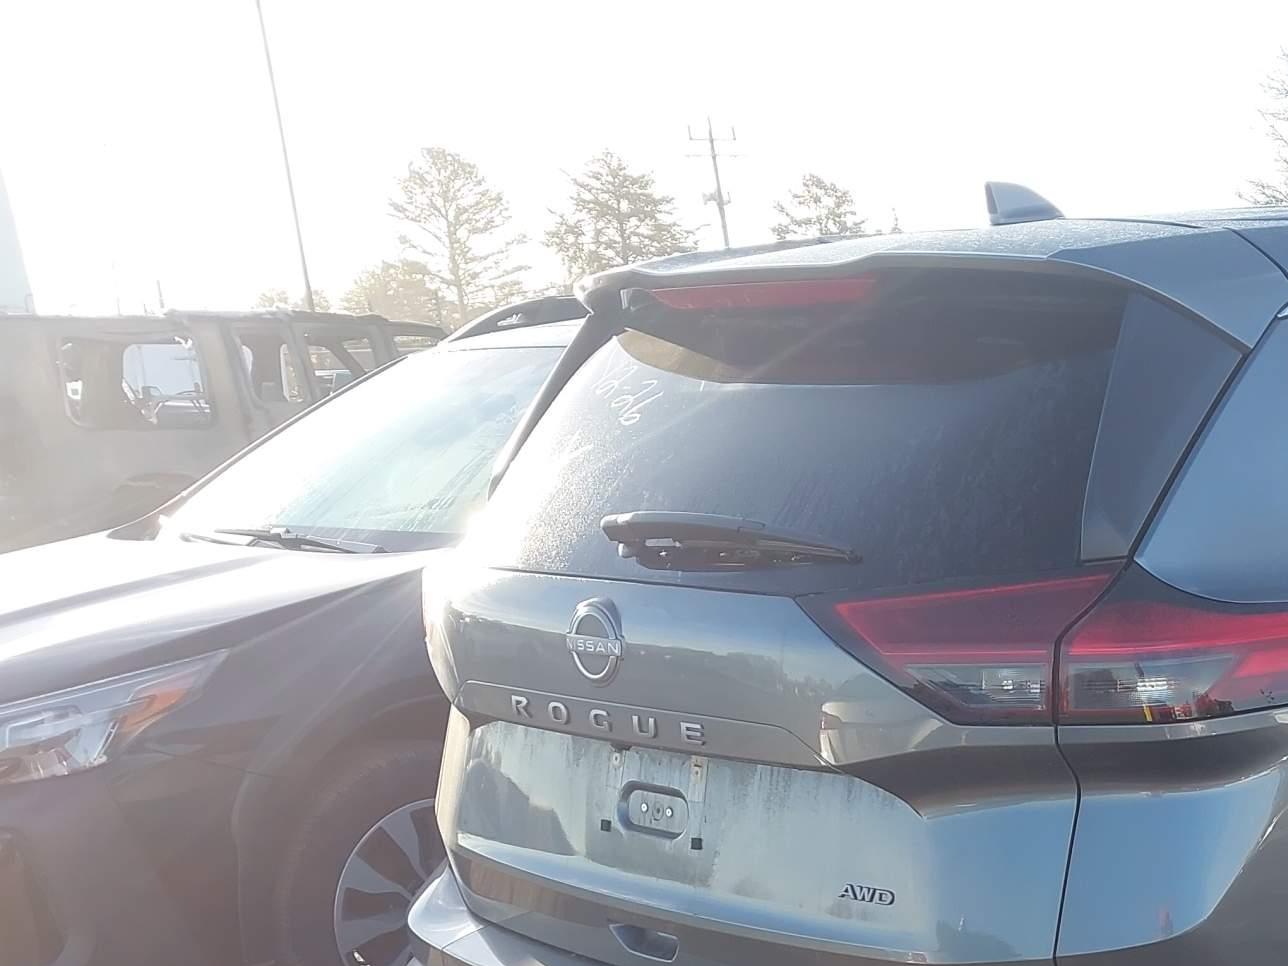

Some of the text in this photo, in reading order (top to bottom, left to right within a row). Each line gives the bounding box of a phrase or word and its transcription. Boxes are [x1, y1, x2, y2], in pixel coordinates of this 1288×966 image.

[567, 638, 621, 655] NISSAN
[511, 694, 707, 746] ROGUE
[838, 883, 895, 906] AWD
